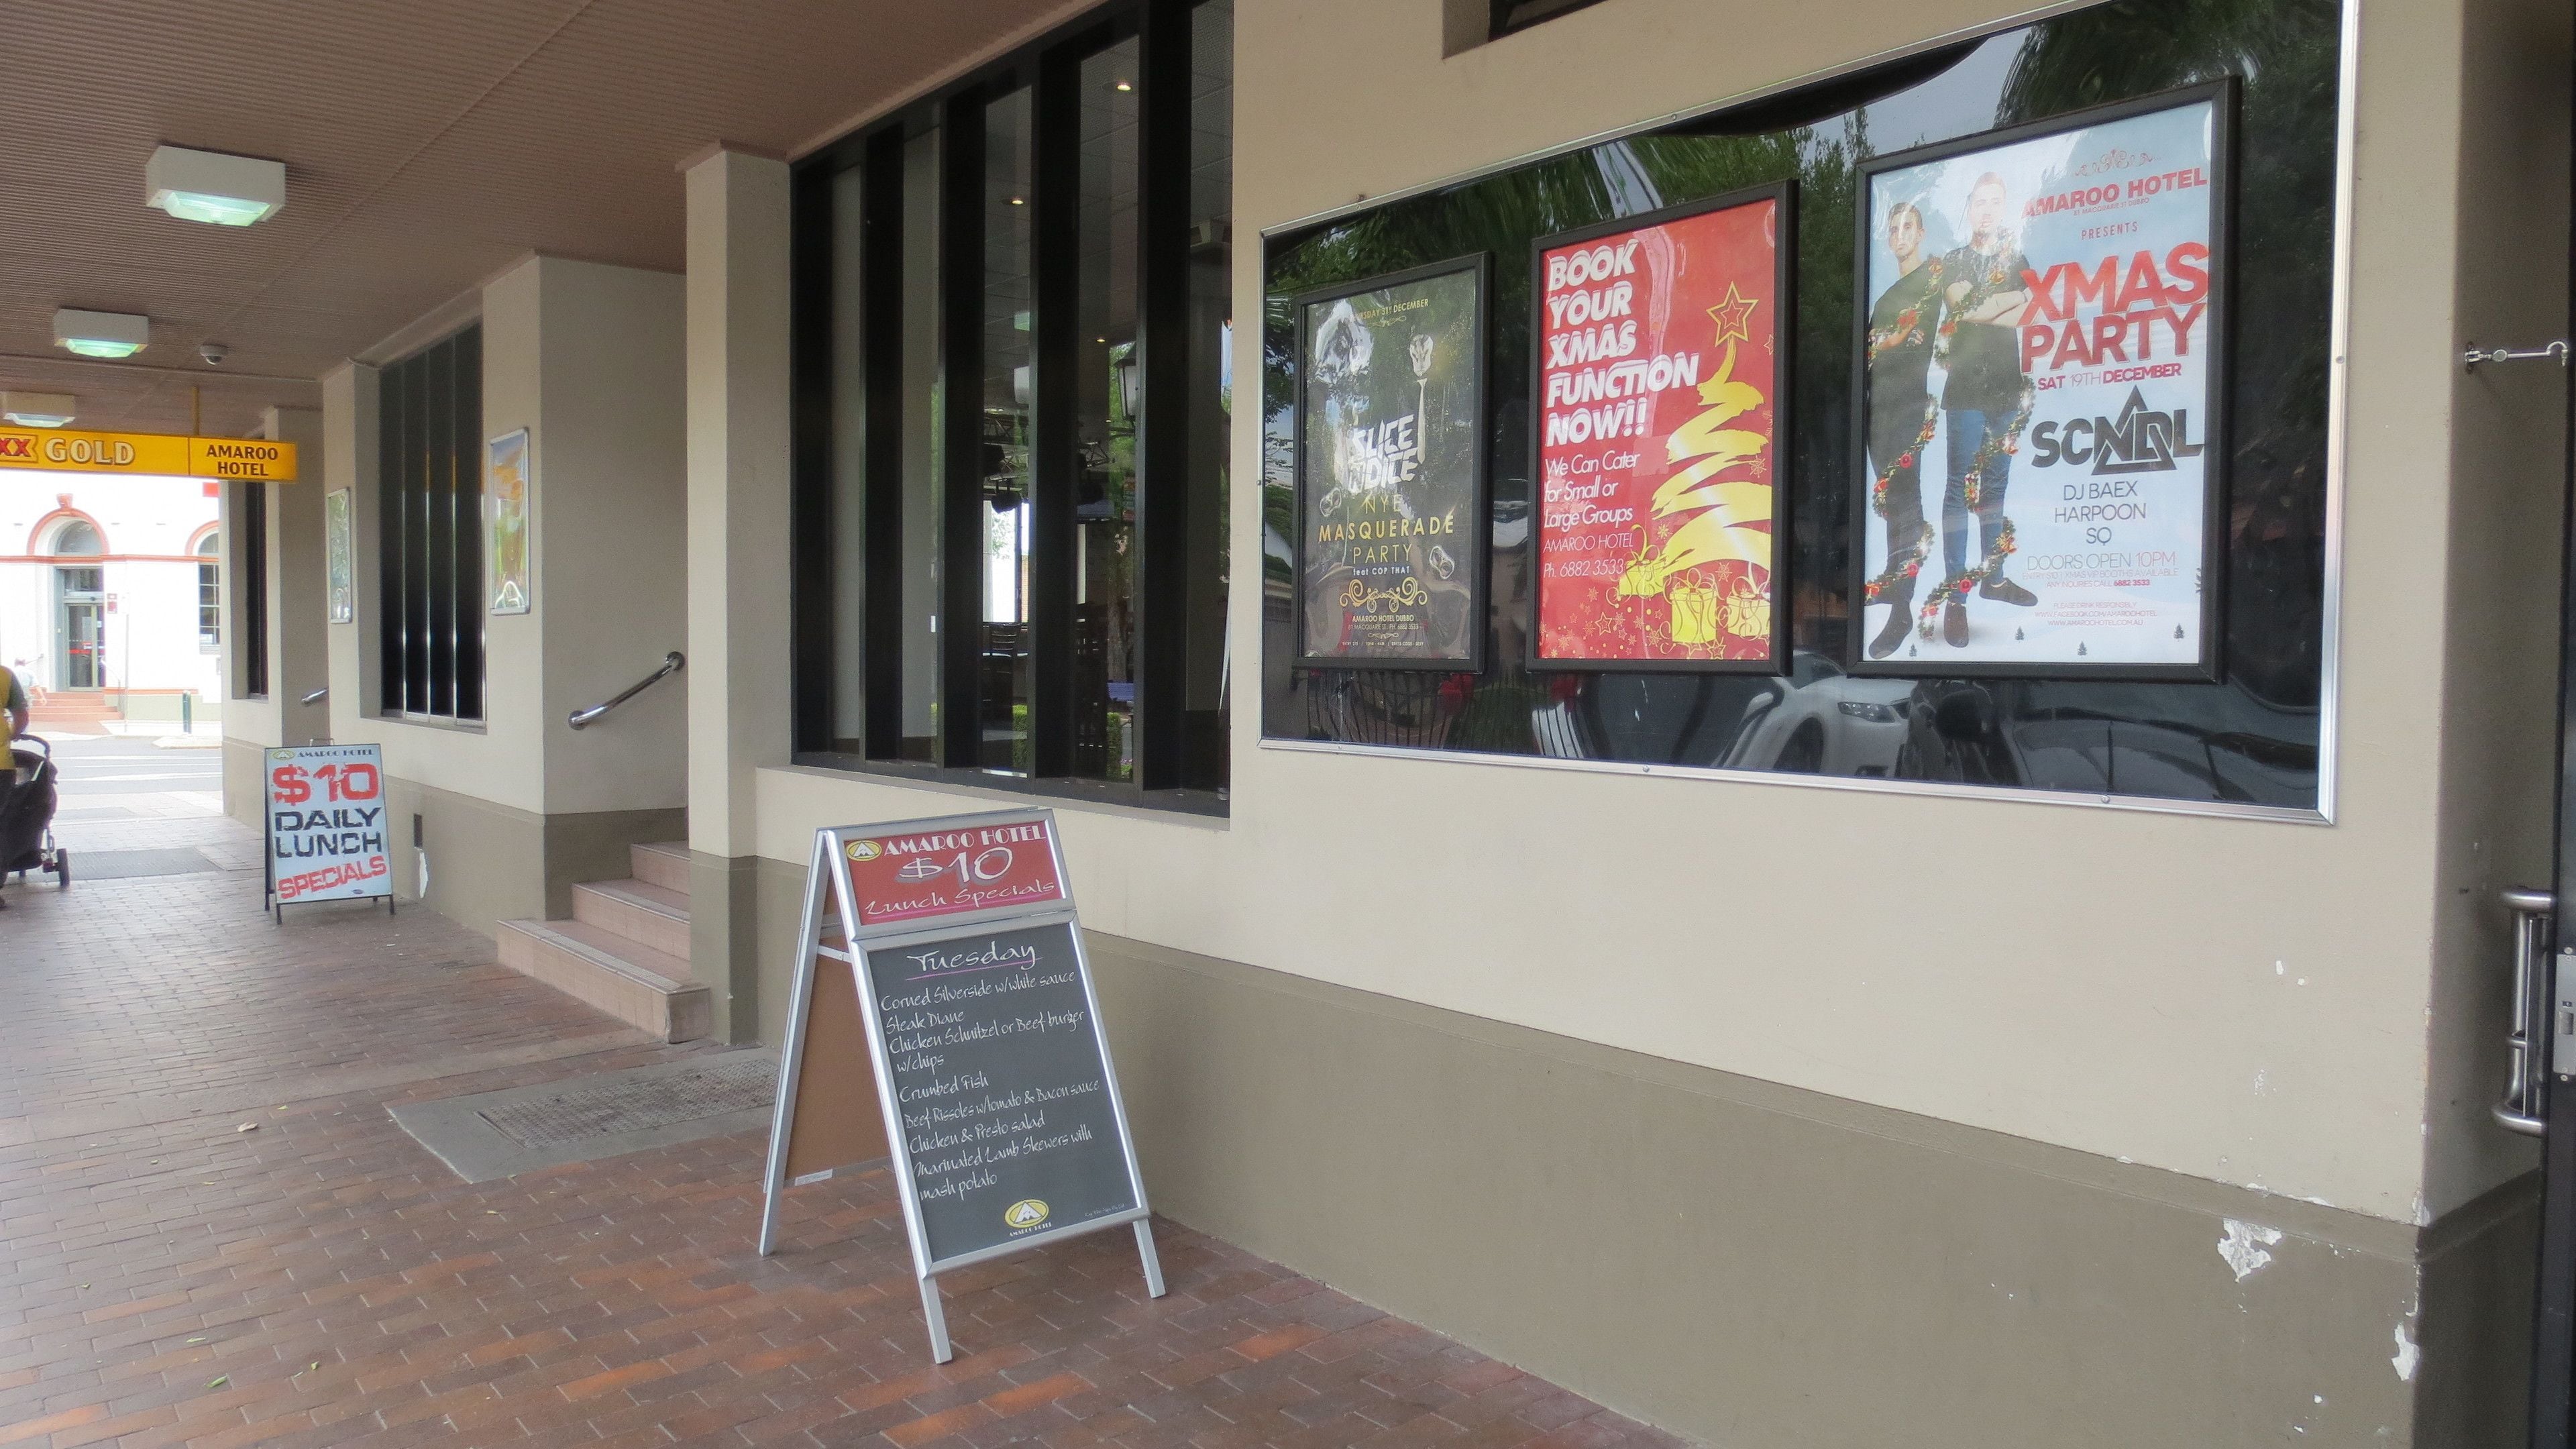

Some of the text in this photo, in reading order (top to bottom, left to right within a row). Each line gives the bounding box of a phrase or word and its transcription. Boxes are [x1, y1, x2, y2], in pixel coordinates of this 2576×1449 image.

[2022, 168, 2208, 219] AMAROO HOTEL
[2082, 221, 2138, 240] PRESENTS
[1548, 239, 1639, 291] BOOK
[2017, 241, 2209, 327] XMAS
[1393, 299, 1429, 313] DECEMBER
[1548, 280, 1633, 329] YOUR
[1546, 320, 1637, 369] XMAS
[2021, 303, 2207, 374] PARTY
[1547, 352, 1699, 408] FUNCTION
[2037, 362, 2182, 391] SAT 19TH DECEMBER
[1546, 397, 1648, 447] NOW!!
[44, 437, 134, 466] GOLD
[206, 444, 278, 461] AMAROO
[1546, 450, 1640, 477] We Can Cater
[217, 462, 268, 476] HOTEL
[1544, 476, 1618, 502] for Small or
[2063, 480, 2138, 501] DJ BAEX
[1544, 504, 1633, 532] Large Groups
[2055, 503, 2147, 523] HARPOON
[1318, 515, 1454, 542] MASQUERADE
[1544, 533, 1633, 553] AMAROO HOTEL
[2086, 527, 2112, 546] SQ
[1353, 543, 1413, 564] PARTY
[1544, 558, 1623, 578] Ph. 6882 3533
[2027, 551, 2176, 571] DOORS OPEN 10PM
[1391, 566, 1410, 575] THAT
[2100, 569, 2133, 578] BOOTHS
[2135, 568, 2179, 577] AVAILABLE
[272, 763, 380, 806] $10
[274, 807, 382, 832] DAILY
[274, 831, 382, 859] LUNCH
[884, 825, 1046, 857] AMAROO HOTEL
[277, 855, 387, 900] SPECIALS
[898, 847, 1014, 883] $10
[865, 879, 1055, 915] Lunch Specials
[906, 941, 1036, 971] Tuesday
[880, 971, 1075, 1011] Corned Silverside w/white sauce
[885, 1010, 965, 1034] Steak Diane
[890, 1010, 1085, 1055] Chicken Schnitzel or Beef burger
[896, 1053, 945, 1075] w/chips
[899, 1071, 989, 1102] Crumbed Fish
[904, 1079, 1100, 1130] Beef Rissoles w/tomato & Bacon sauce
[910, 1132, 959, 1154] Chicken
[961, 1128, 973, 1142] &
[1011, 1110, 1046, 1132] salad
[914, 1124, 1093, 1177] Marinated Lamb Skewers with
[920, 1168, 998, 1201] mash potato
